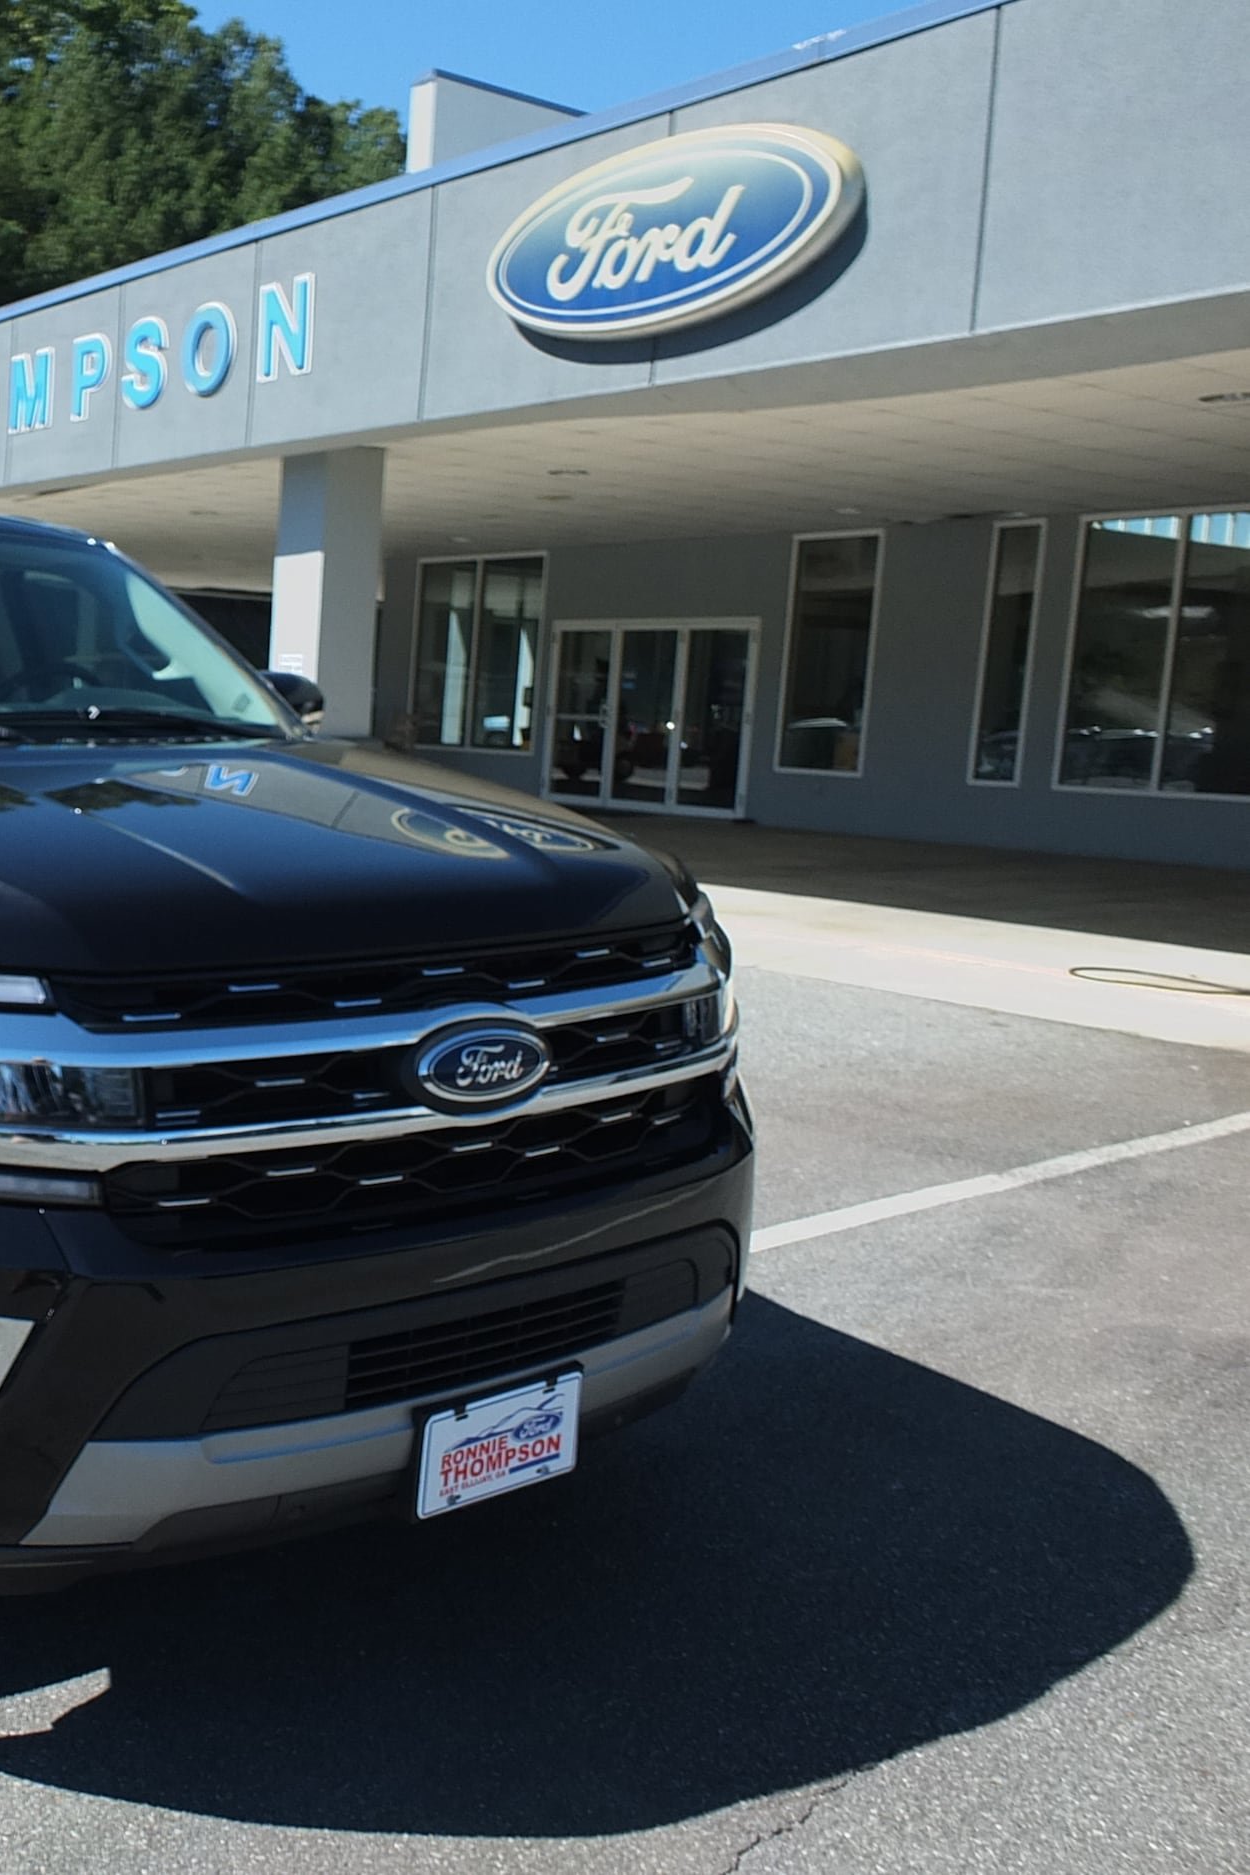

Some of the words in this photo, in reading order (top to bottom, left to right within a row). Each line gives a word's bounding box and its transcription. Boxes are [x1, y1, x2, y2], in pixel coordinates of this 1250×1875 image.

[546, 176, 746, 301] Ford
[455, 1044, 524, 1087] Ford
[519, 1415, 555, 1439] Ford
[440, 1433, 562, 1488] THOMPSON
[441, 1435, 509, 1472] RONNIE
